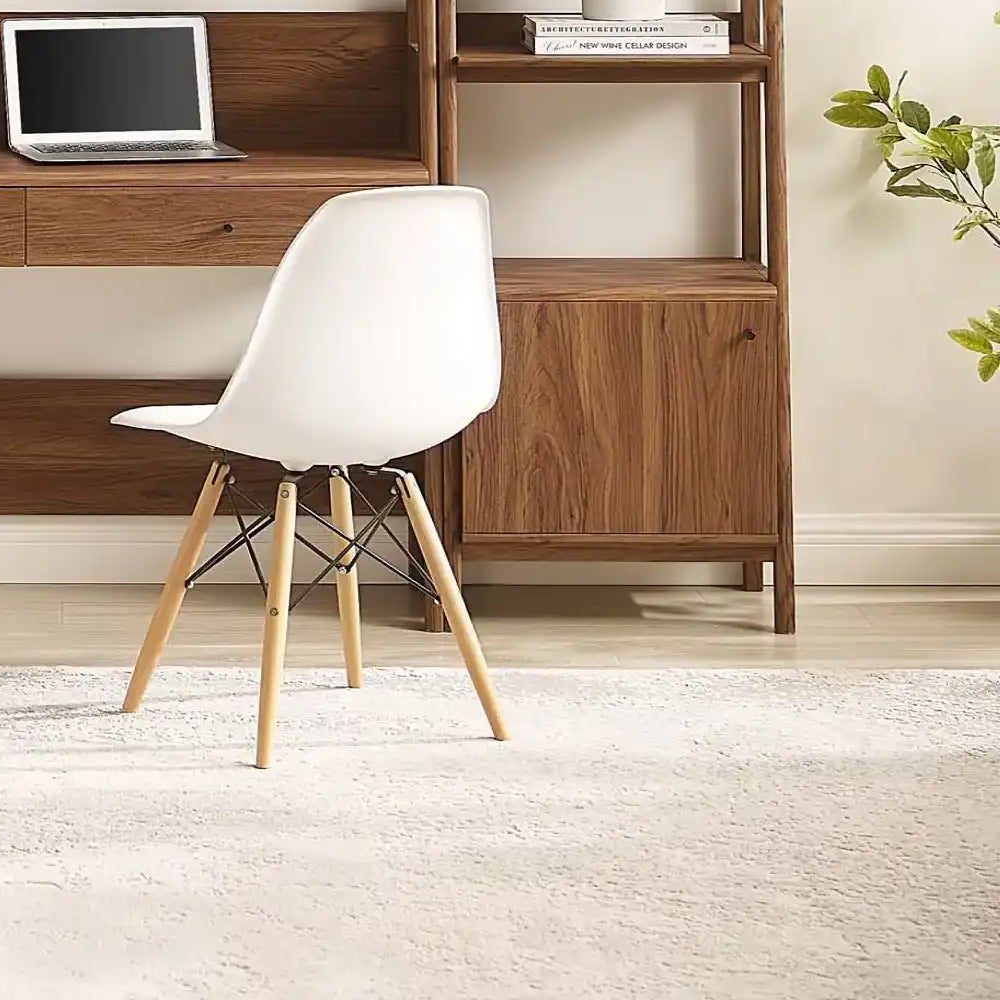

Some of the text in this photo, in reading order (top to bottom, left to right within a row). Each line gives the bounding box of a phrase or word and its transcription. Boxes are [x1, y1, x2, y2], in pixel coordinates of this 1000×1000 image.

[579, 42, 598, 50] NEW
[600, 42, 623, 50] WINE
[625, 42, 654, 50] CELLAR
[656, 42, 688, 50] DESIGN
